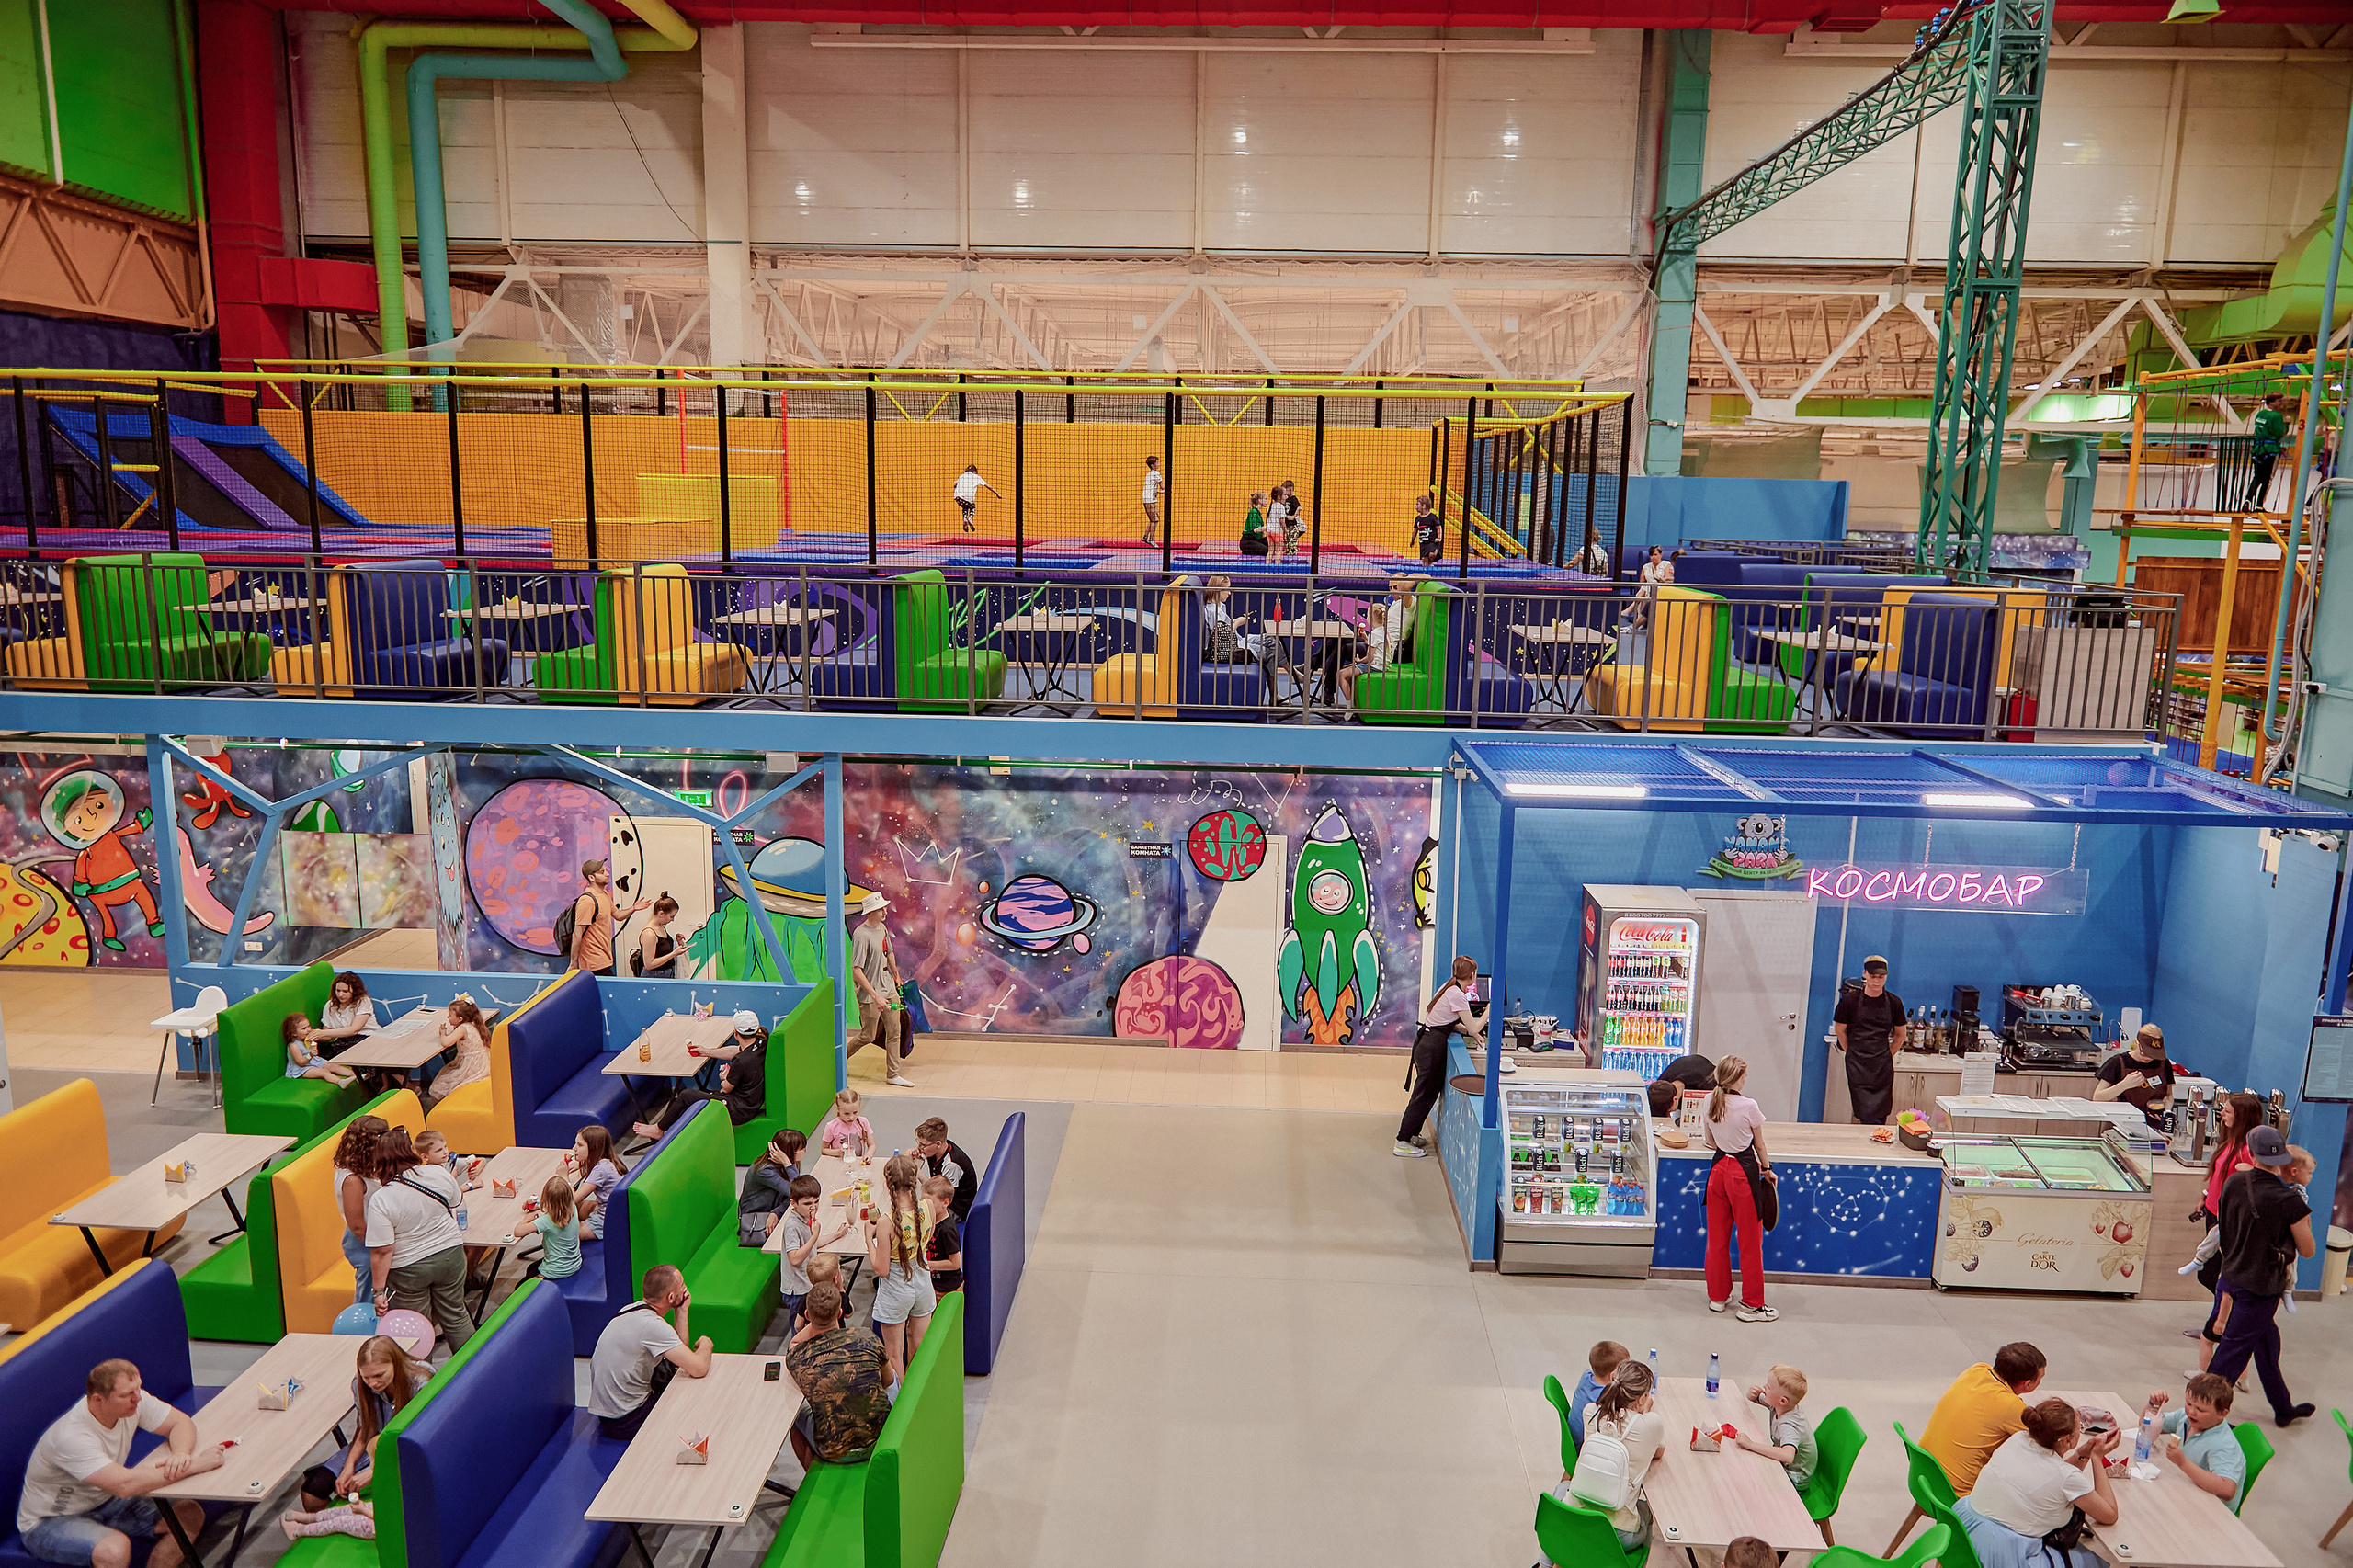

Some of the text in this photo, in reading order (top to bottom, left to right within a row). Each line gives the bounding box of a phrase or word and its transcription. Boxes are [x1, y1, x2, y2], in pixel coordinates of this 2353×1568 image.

[2298, 419, 2306, 431] 3
[1807, 868, 2045, 907] КОСМОБАР
[1536, 1122, 1544, 1138] Rich
[2164, 1117, 2173, 1132] Rich
[2017, 1232, 2075, 1248] Gelateria
[2031, 1253, 2057, 1261] CARTE
